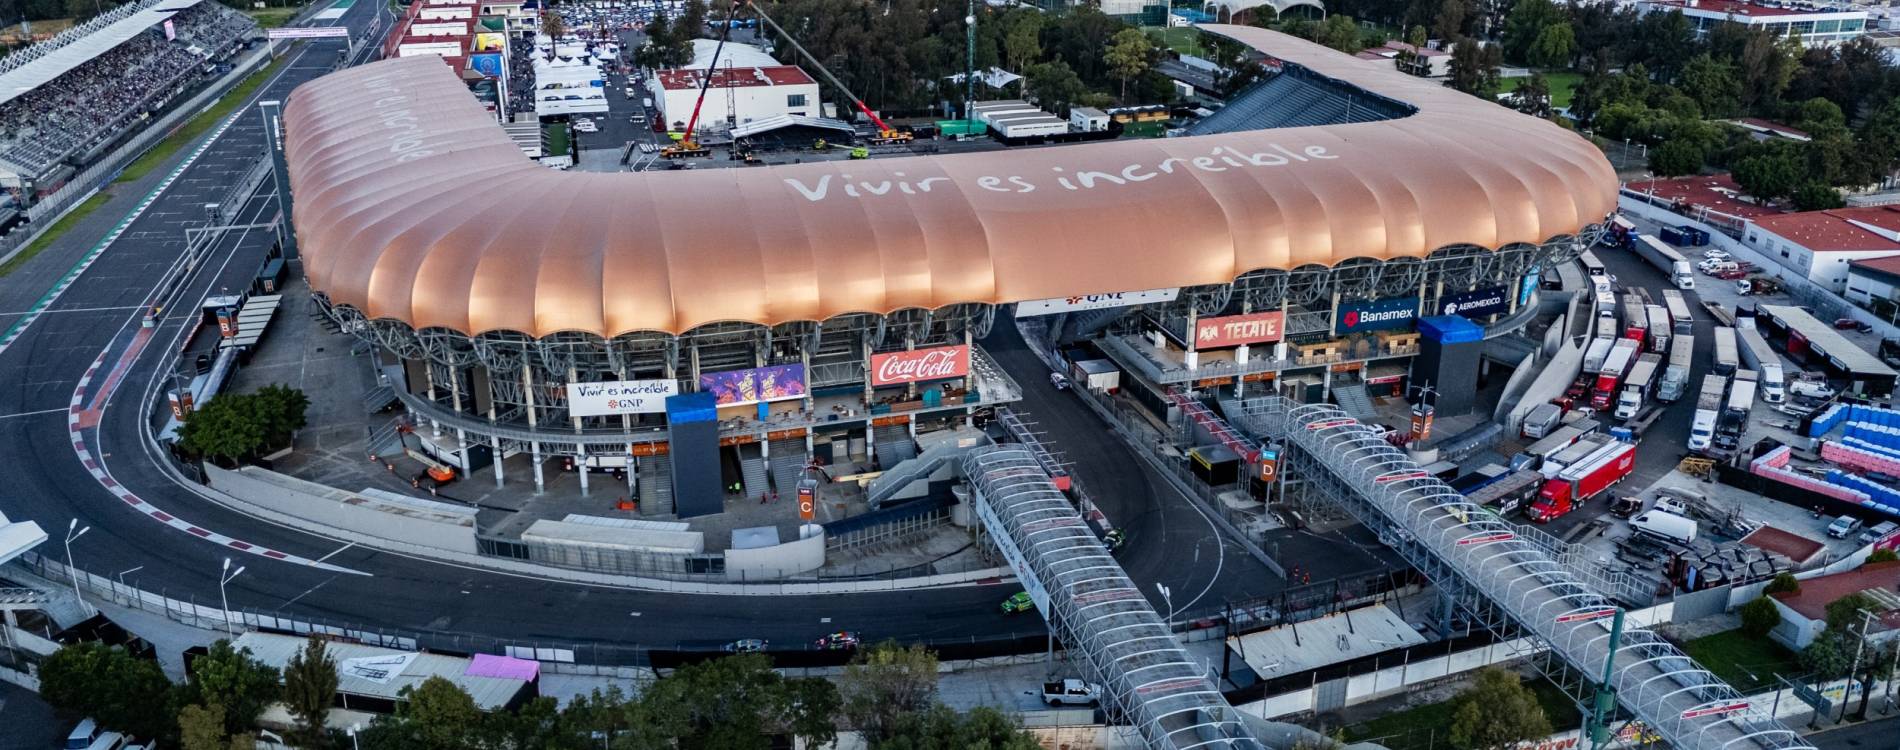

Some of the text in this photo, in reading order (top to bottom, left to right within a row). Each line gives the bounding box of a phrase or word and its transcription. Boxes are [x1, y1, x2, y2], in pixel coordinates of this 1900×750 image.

[784, 143, 1340, 201] Vivir es increíble
[1458, 297, 1501, 311] AEROMEXICO
[1360, 309, 1413, 323] Banamex
[1223, 319, 1278, 340] TECATE
[578, 383, 669, 397] Vivir es increíble
[619, 399, 643, 408] GNP
[1412, 421, 1421, 434] E
[1263, 463, 1274, 475] D
[800, 501, 812, 513] C
